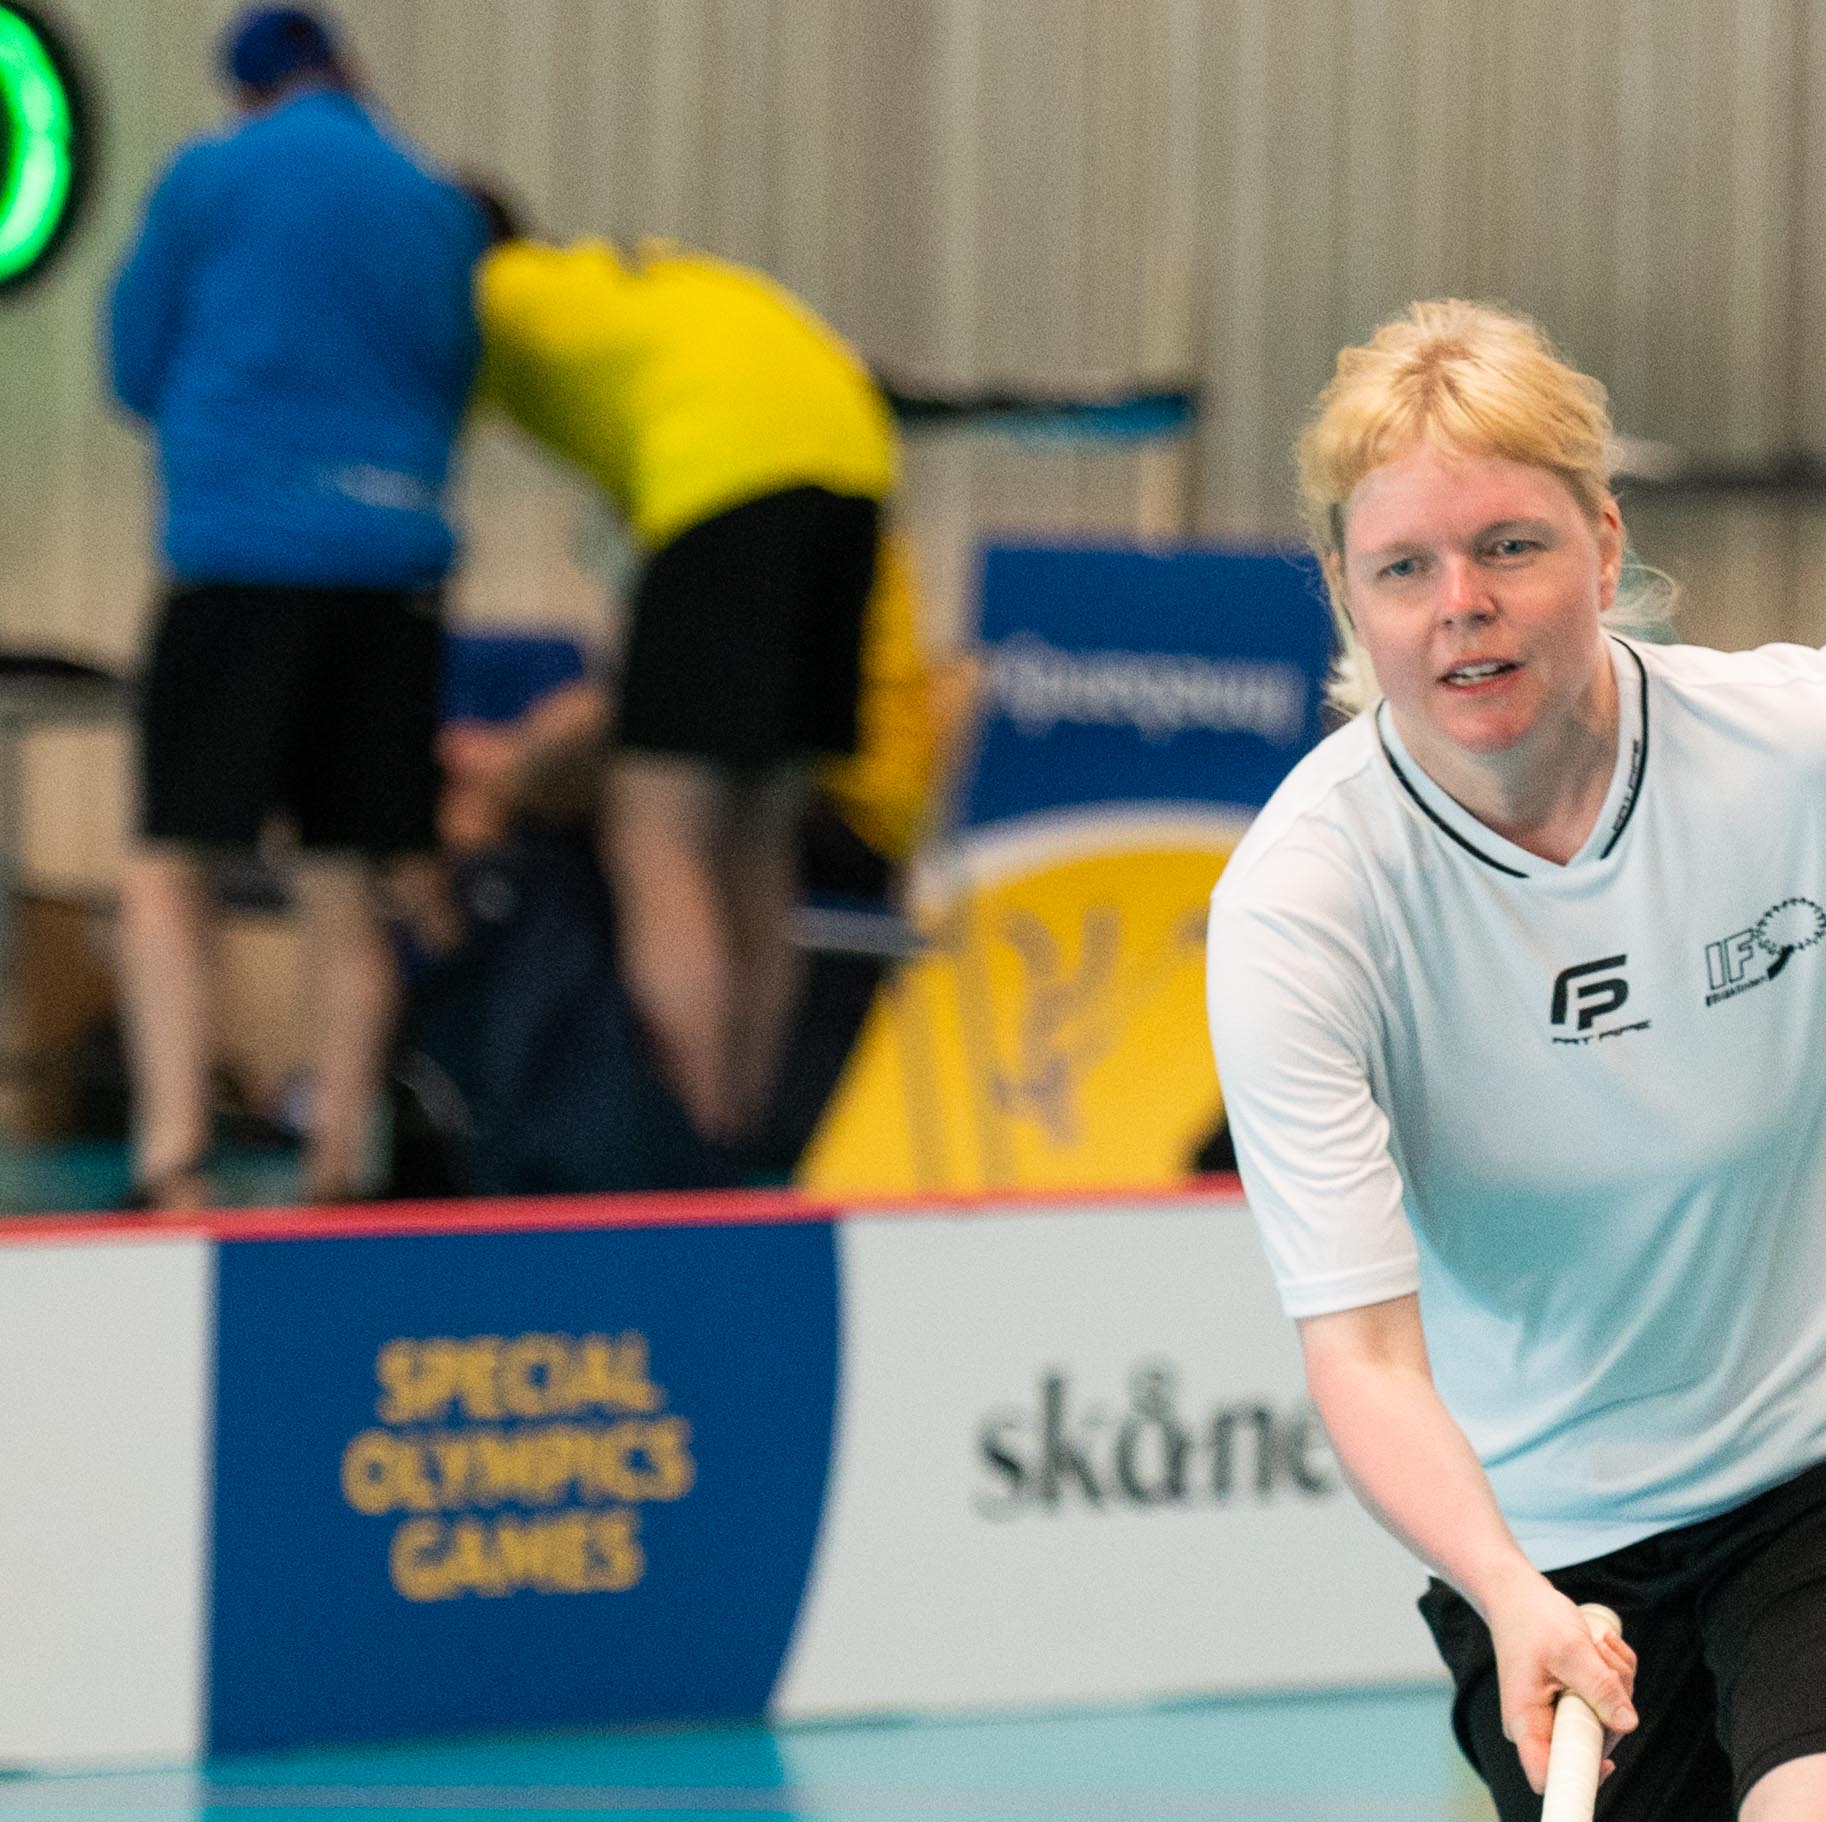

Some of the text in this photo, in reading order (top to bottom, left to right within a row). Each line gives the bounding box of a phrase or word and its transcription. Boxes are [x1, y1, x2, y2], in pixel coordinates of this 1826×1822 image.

[379, 1331, 665, 1424] SPECIAL
[342, 1416, 694, 1515] OLYMPICS
[391, 1507, 644, 1600] GAMES
